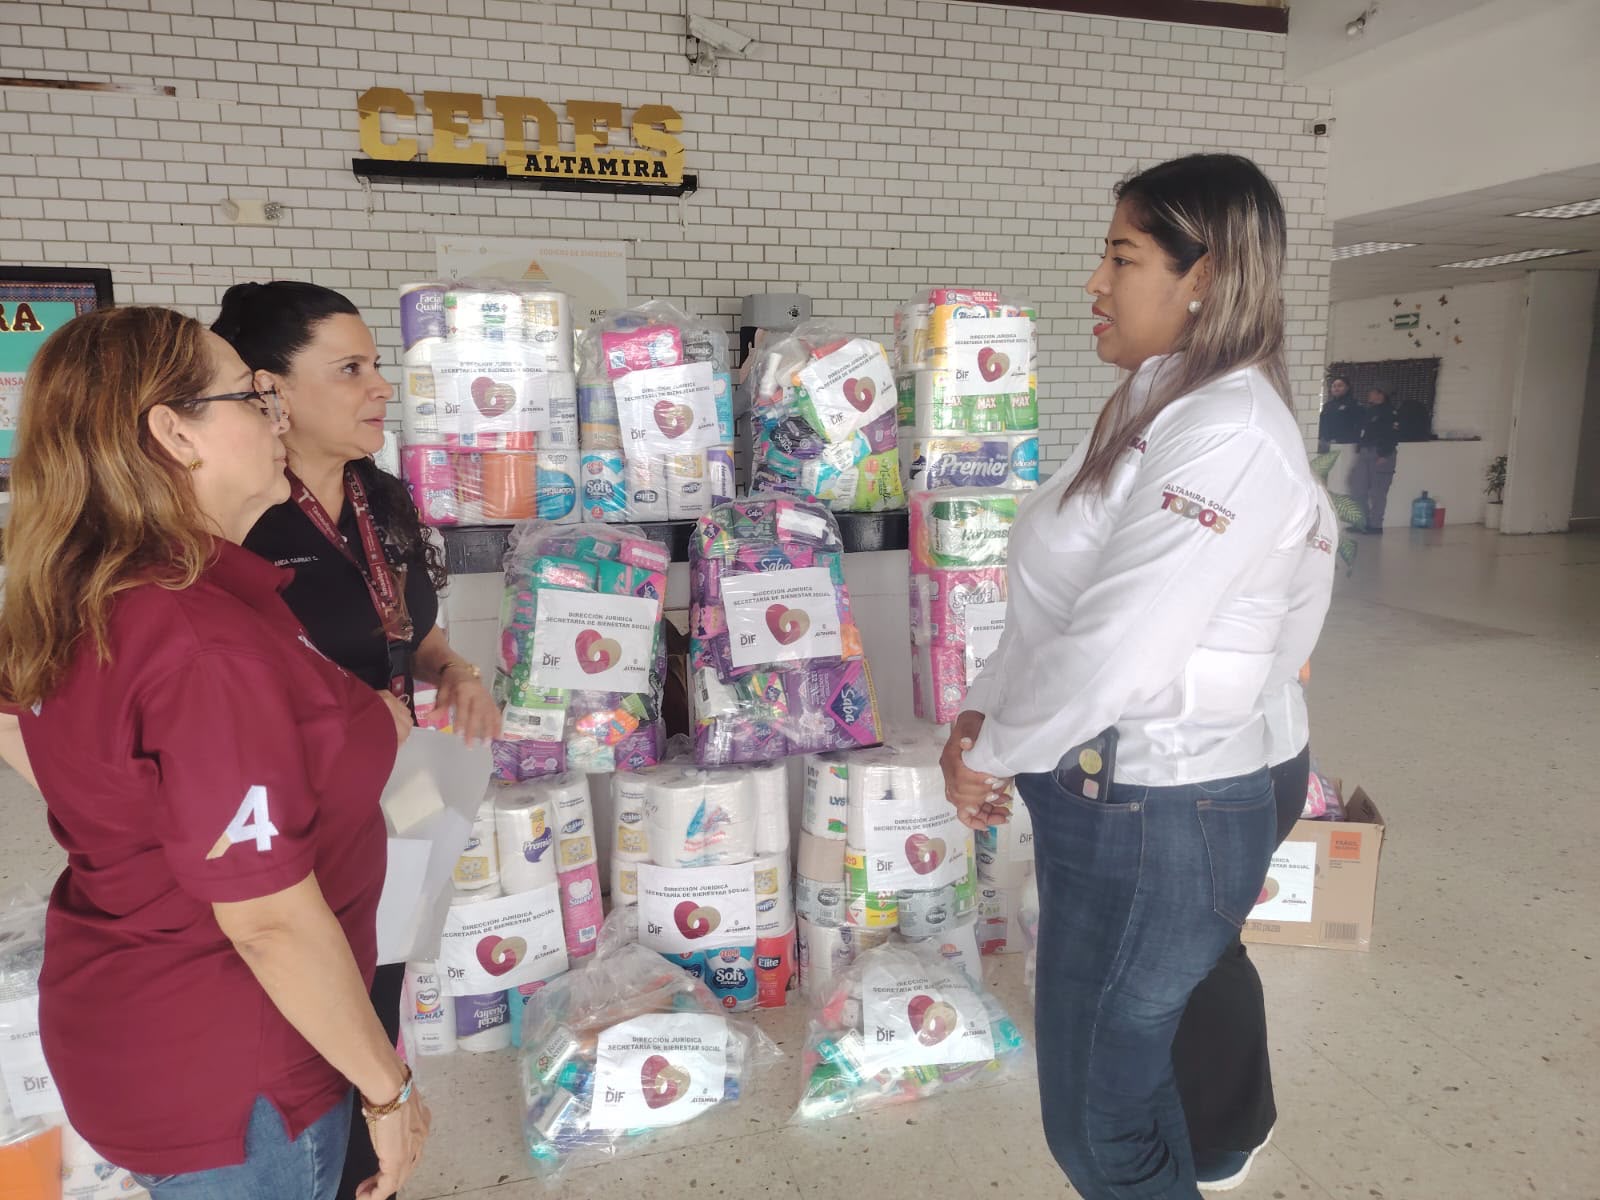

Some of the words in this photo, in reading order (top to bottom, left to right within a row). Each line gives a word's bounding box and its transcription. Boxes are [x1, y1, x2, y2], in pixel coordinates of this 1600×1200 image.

[357, 86, 685, 162] CEDES
[524, 154, 669, 179] ALTAMIRA
[955, 370, 969, 380] DIF
[445, 403, 461, 414] DIF
[630, 429, 647, 440] DIF
[938, 453, 1008, 477] Premier
[586, 480, 613, 493] Soft
[1164, 483, 1207, 504] ALTAMIRA
[1207, 499, 1236, 521] SOMOS
[1161, 491, 1231, 535] TODOS
[740, 634, 757, 646] DIF
[542, 654, 561, 666] DIF
[522, 834, 552, 852] Premi
[1019, 835, 1033, 844] DIF
[876, 861, 894, 872] DIF
[461, 918, 500, 931] DIRECCIÓN
[501, 911, 534, 922] JURÍDICA
[483, 926, 492, 934] DE
[493, 918, 532, 930] BIENESTAR
[532, 908, 555, 920] SOCIAL
[647, 924, 663, 935] DIF
[757, 957, 780, 967] Elite
[416, 975, 436, 984] 4XL
[447, 968, 467, 979] DIF
[715, 967, 746, 983] Soft
[473, 1003, 508, 1018] Quality
[477, 1012, 505, 1029] Facial
[632, 1036, 670, 1044] DIRECCIÓN
[671, 1036, 702, 1044] JURÍDICA
[876, 1029, 896, 1042] DIF
[23, 1077, 49, 1092] DIF
[605, 1089, 626, 1103] DIF
